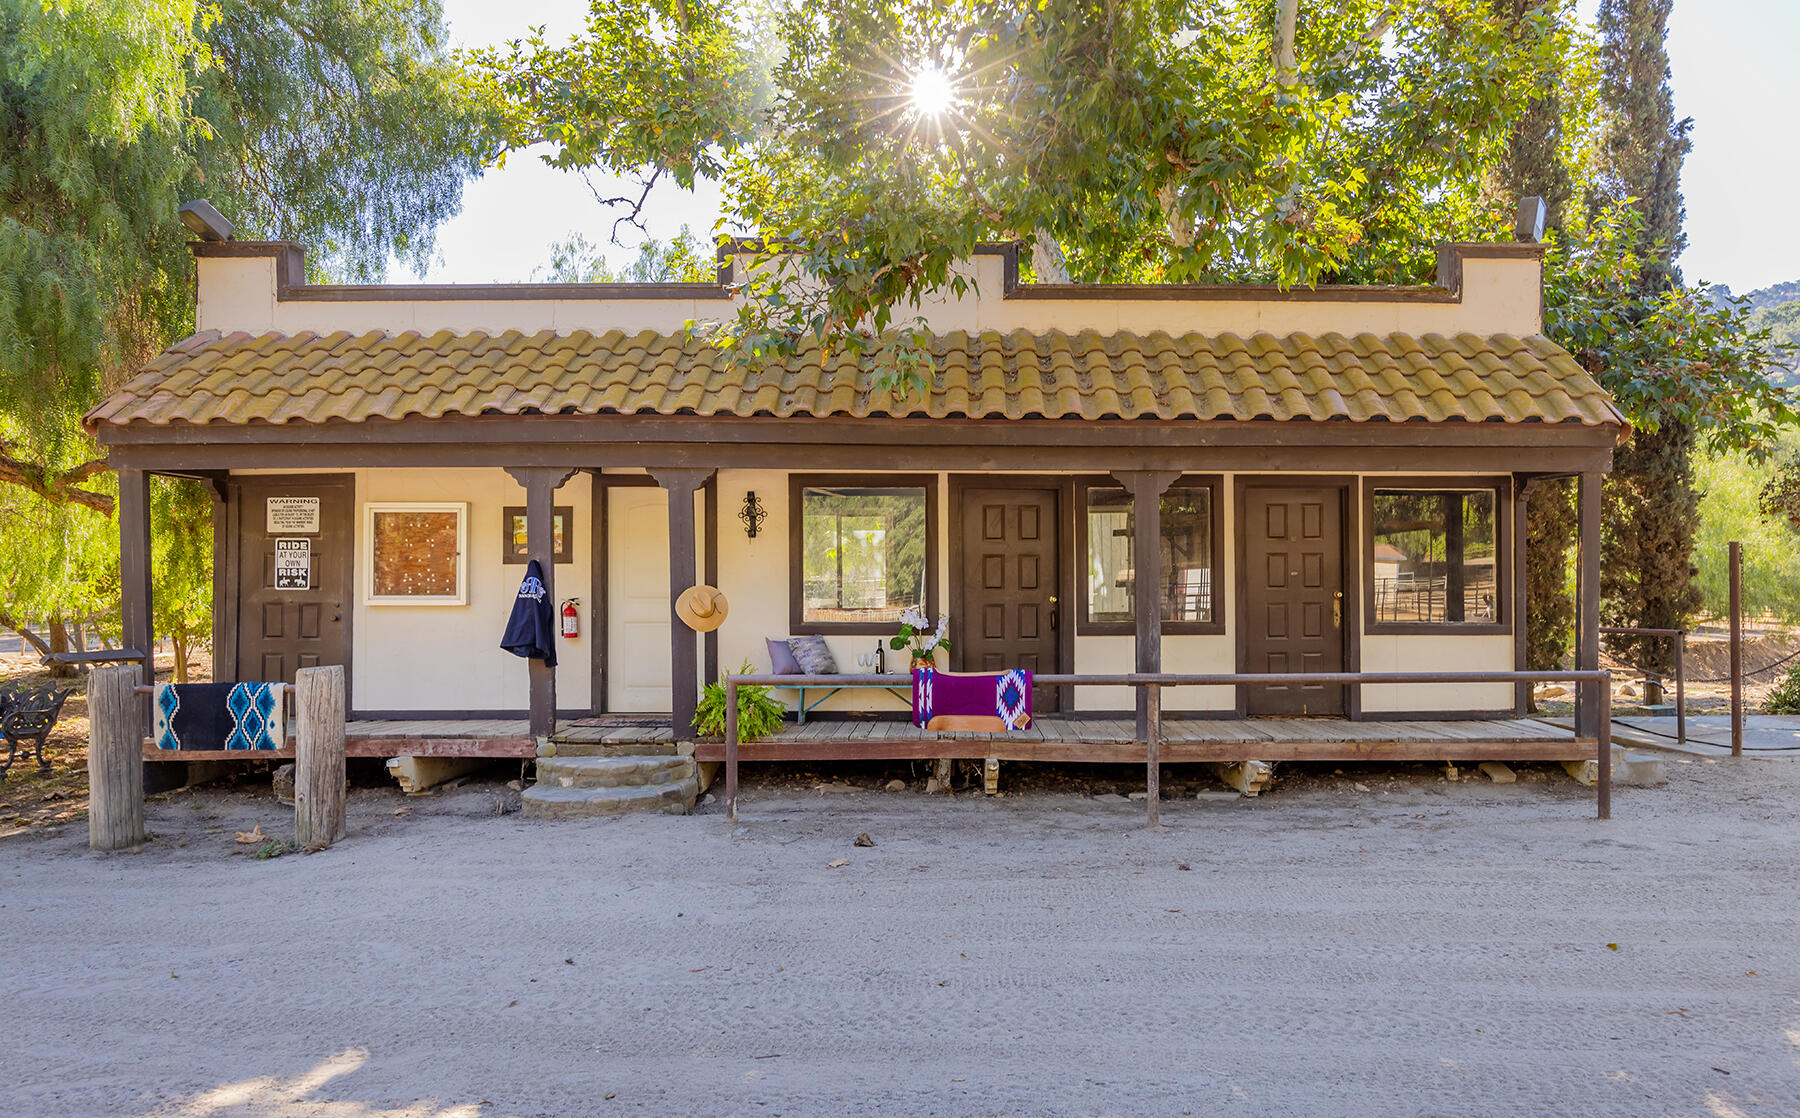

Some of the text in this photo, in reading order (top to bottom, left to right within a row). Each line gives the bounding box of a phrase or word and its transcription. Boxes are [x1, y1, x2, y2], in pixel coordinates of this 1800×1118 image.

[279, 541, 308, 550] RIDE
[289, 551, 307, 559] YOUR
[279, 568, 307, 576] RISK
